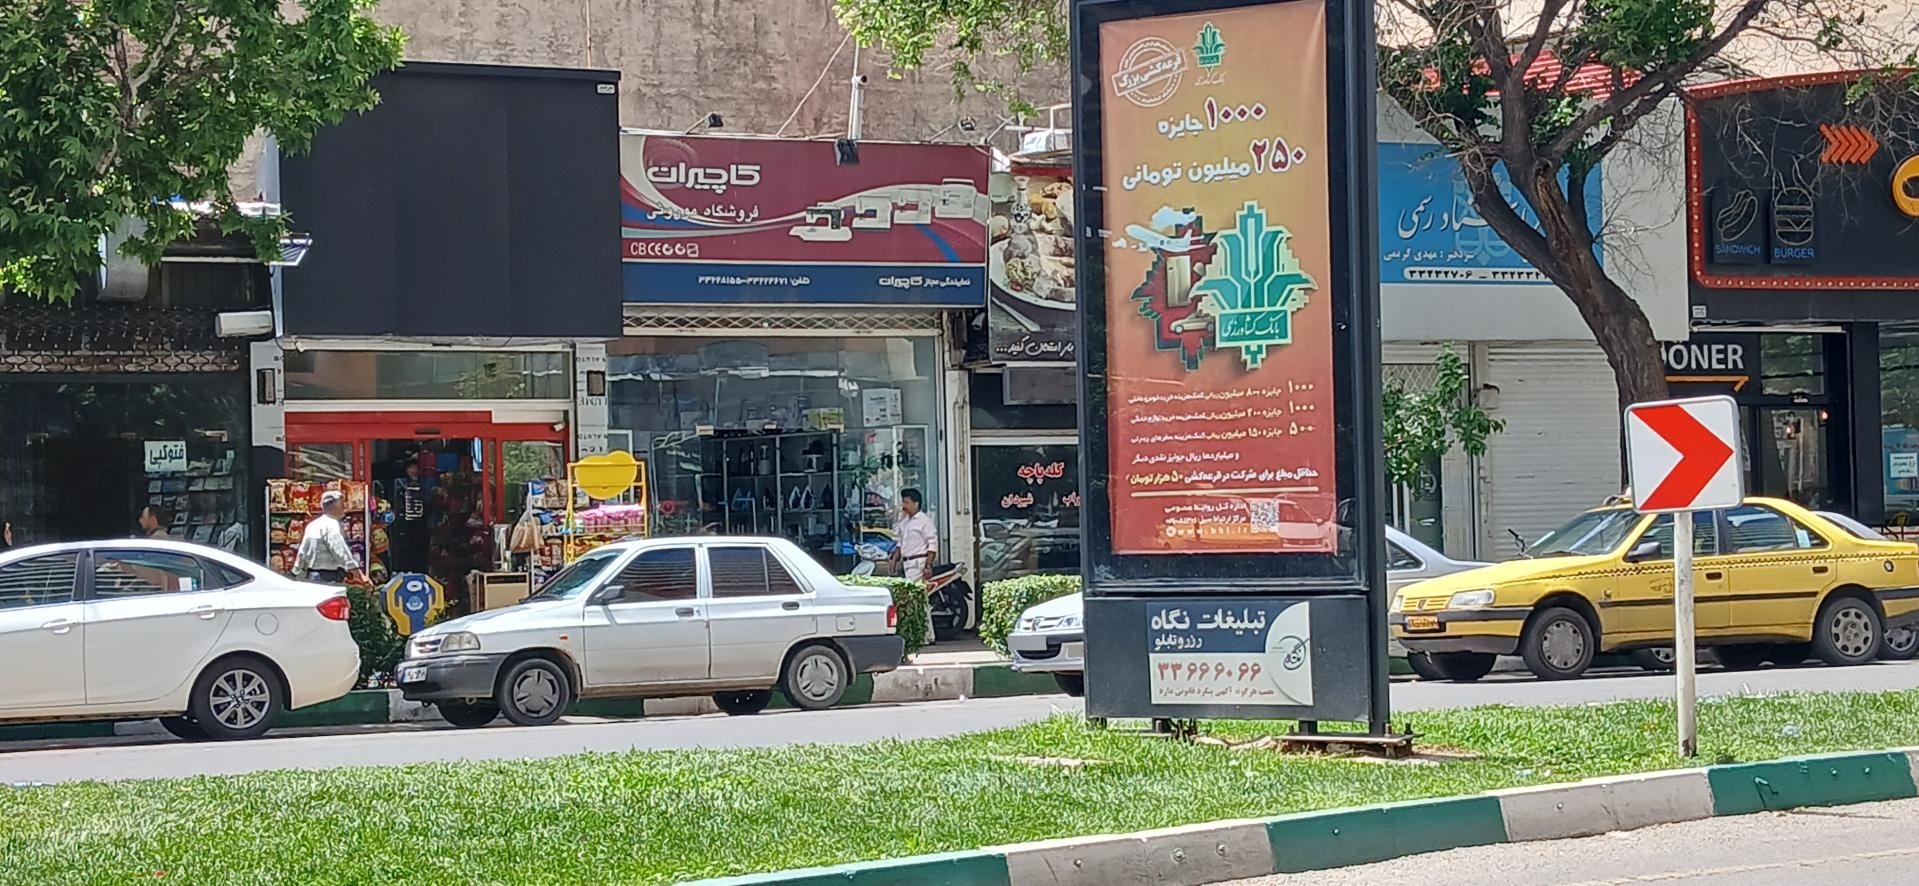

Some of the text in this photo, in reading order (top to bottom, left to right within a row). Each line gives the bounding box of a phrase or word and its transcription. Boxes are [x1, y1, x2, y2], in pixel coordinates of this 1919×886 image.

[1158, 97, 1267, 139] ۱۰۰۰ جایزه
[1122, 137, 1307, 190] ۲۵۰ میلیون تومانی
[646, 162, 761, 194] کاچیران
[703, 204, 759, 222] فروشگاه
[1398, 194, 1435, 239] رسمی
[1383, 248, 1411, 262] کریمی
[1413, 250, 1437, 261] مهدی
[1714, 244, 1761, 255] SANDWICH
[1774, 247, 1815, 259] BURGER
[878, 275, 923, 289] کاچیران
[940, 276, 971, 287] نمایندگی
[1288, 379, 1314, 394] ۱۰۰۰
[1289, 400, 1315, 414] ۱۰۰۰
[1289, 421, 1313, 435] ۵۰۰
[150, 444, 184, 469] فتوکپی
[1017, 461, 1065, 485] کله پاچه
[1221, 472, 1230, 483] در
[1231, 468, 1257, 481] شرکت
[1258, 469, 1274, 481] برای
[1275, 468, 1293, 481] مبلغ
[1293, 467, 1319, 480] حداقل
[1151, 608, 1266, 635] تبلیغات نگاه
[1159, 687, 1174, 697] دارد
[1174, 687, 1196, 697] قانونی
[1214, 686, 1232, 697] آگهی
